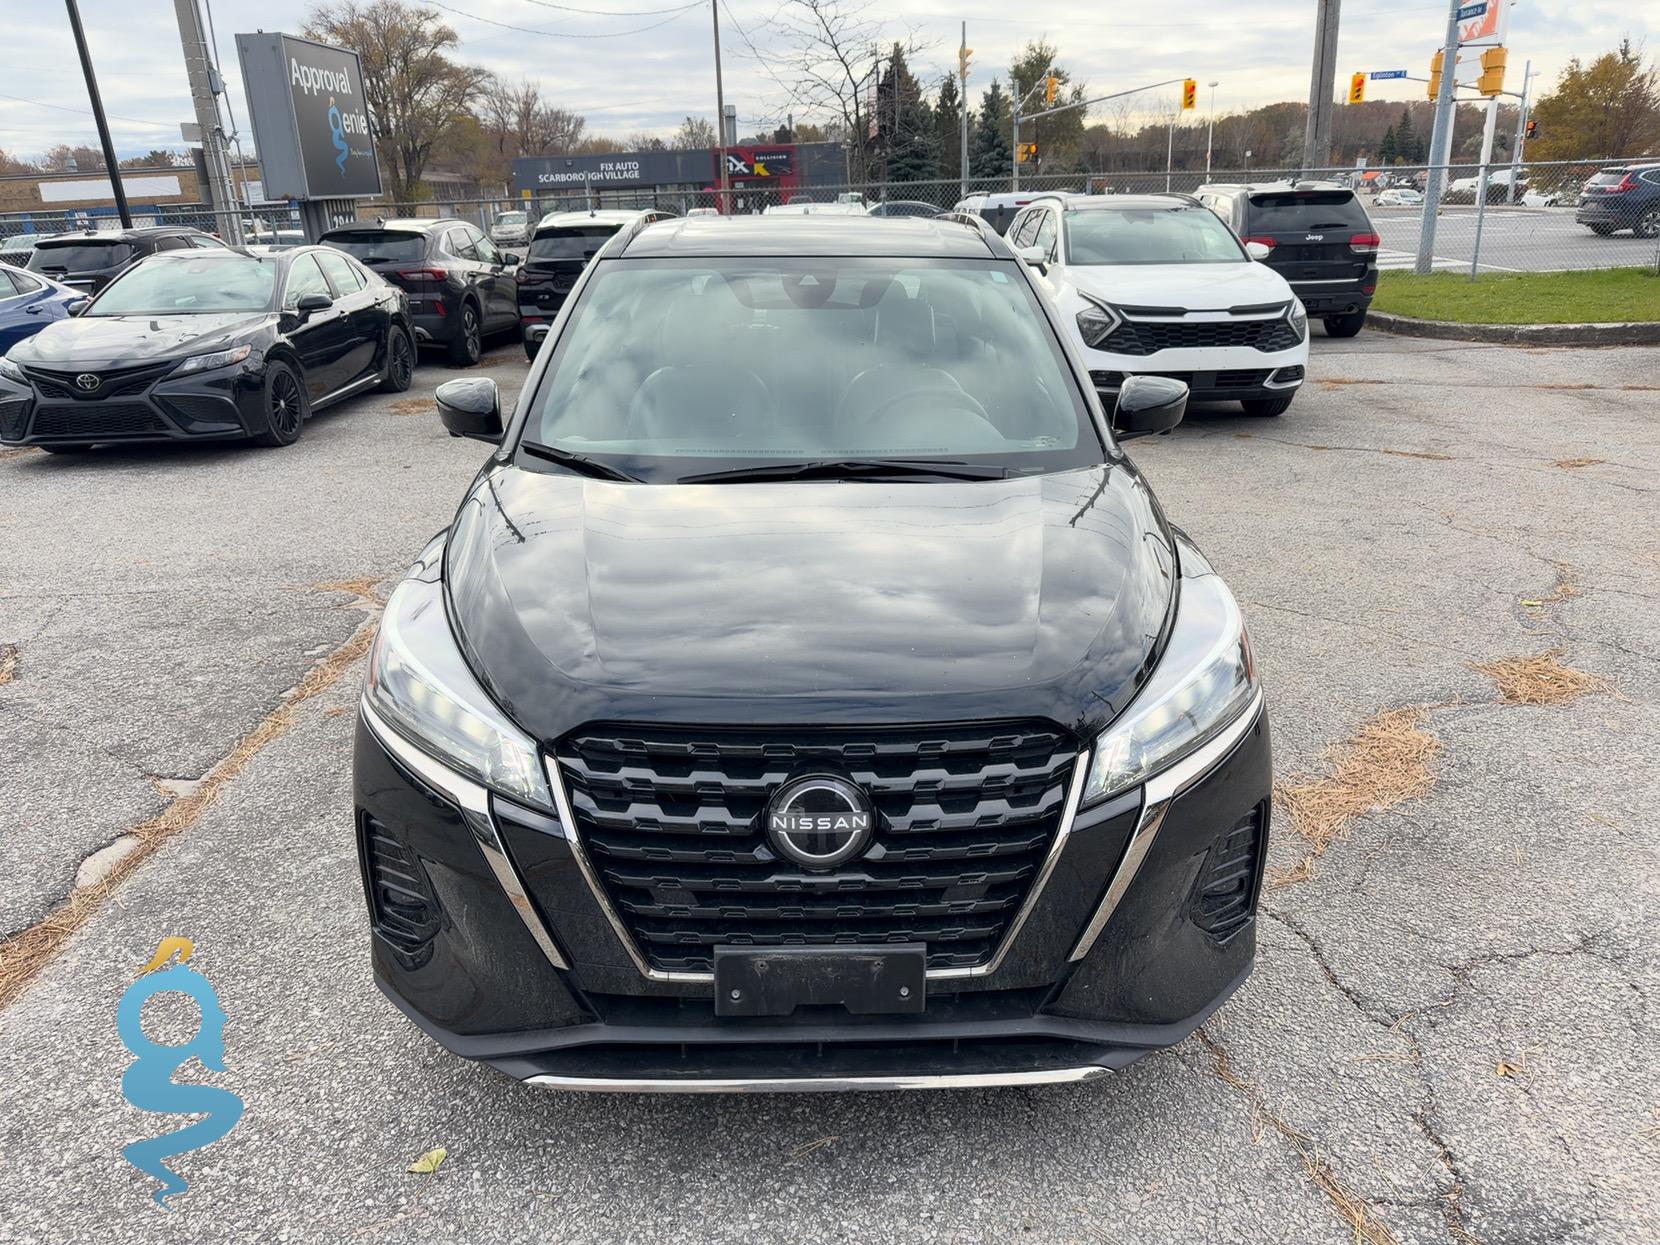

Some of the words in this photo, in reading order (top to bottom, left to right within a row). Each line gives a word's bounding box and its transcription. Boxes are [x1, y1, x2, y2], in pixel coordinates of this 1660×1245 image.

[291, 58, 352, 96] Approval
[600, 163, 614, 171] FIX
[616, 162, 639, 170] AUTO
[604, 170, 640, 180] VILLAGE
[772, 815, 867, 830] NISSAN
